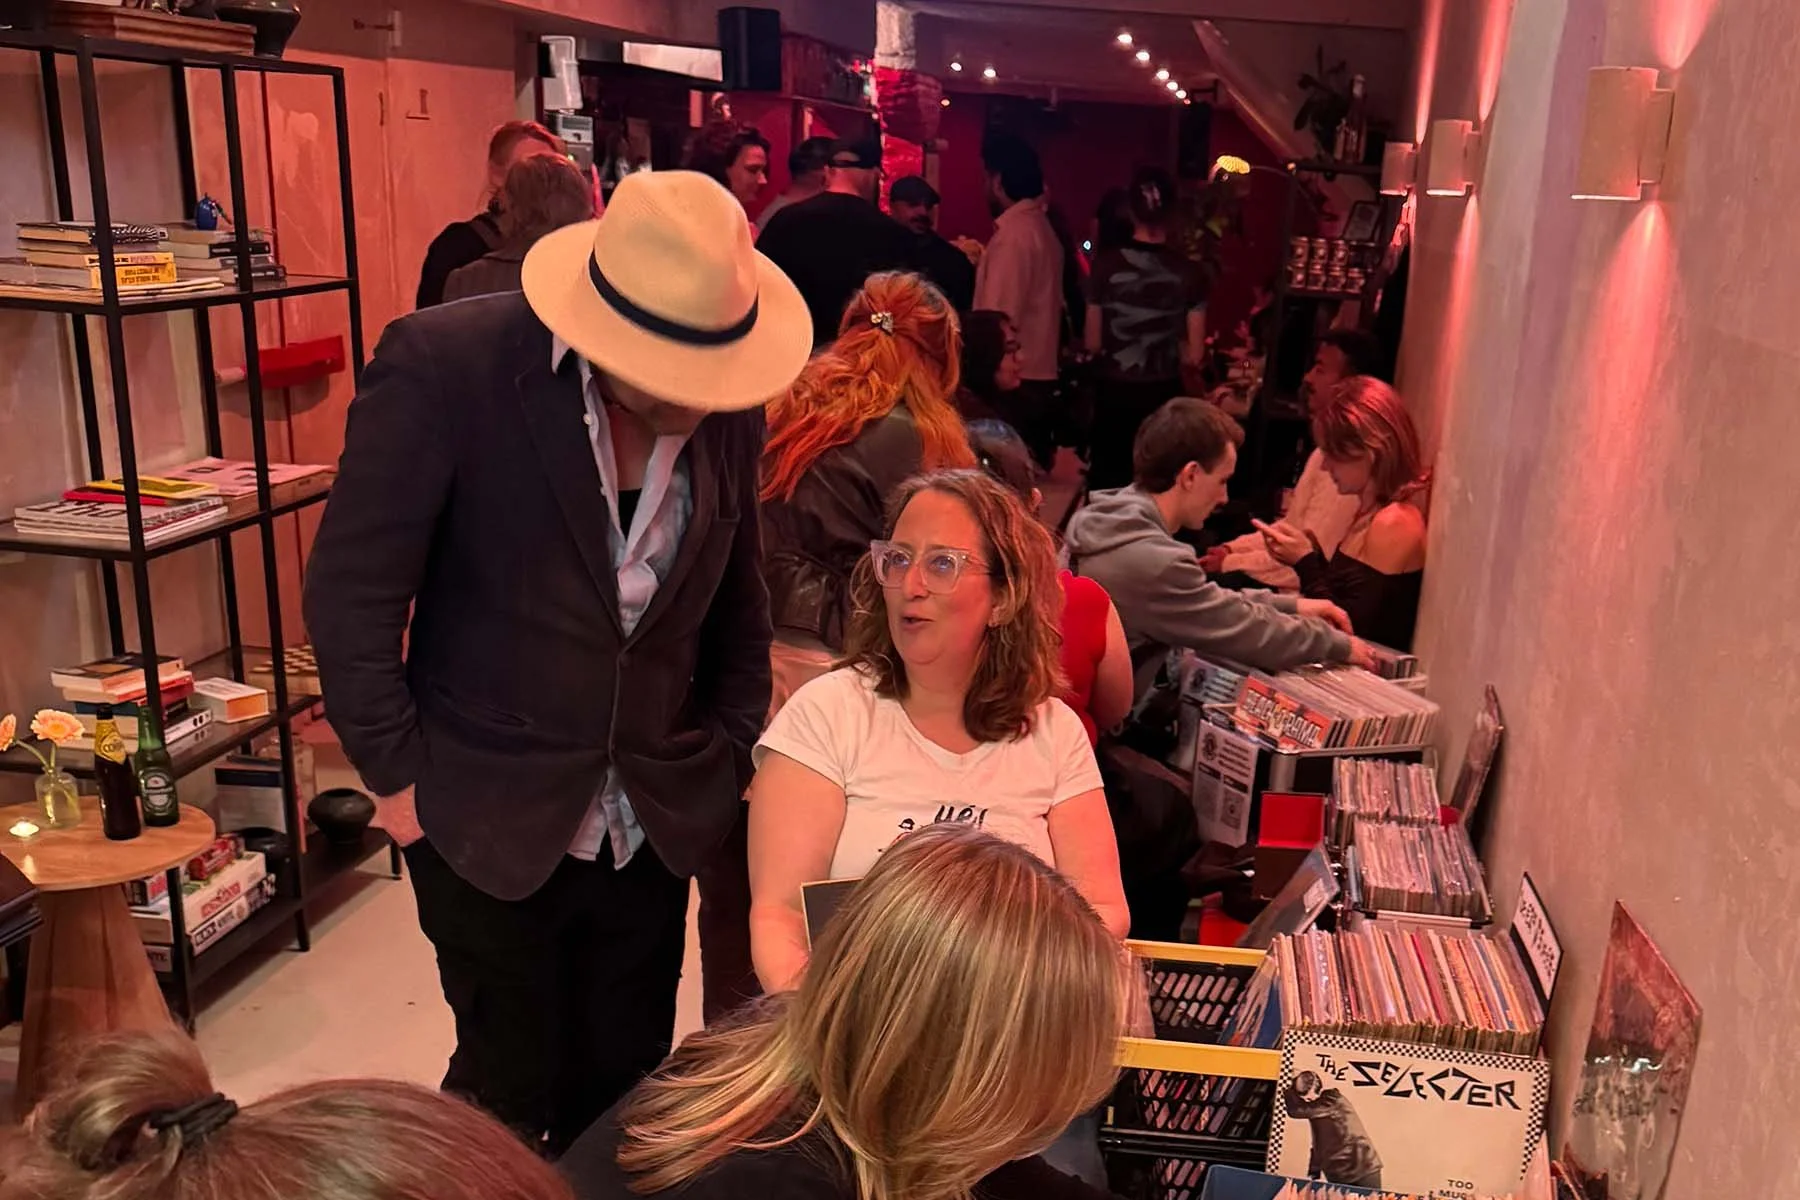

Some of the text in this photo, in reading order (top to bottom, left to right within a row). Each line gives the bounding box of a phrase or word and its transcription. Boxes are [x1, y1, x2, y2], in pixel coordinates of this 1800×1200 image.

[1315, 1053, 1522, 1110] THE SELECTER
[1447, 1179, 1474, 1191] TOO
